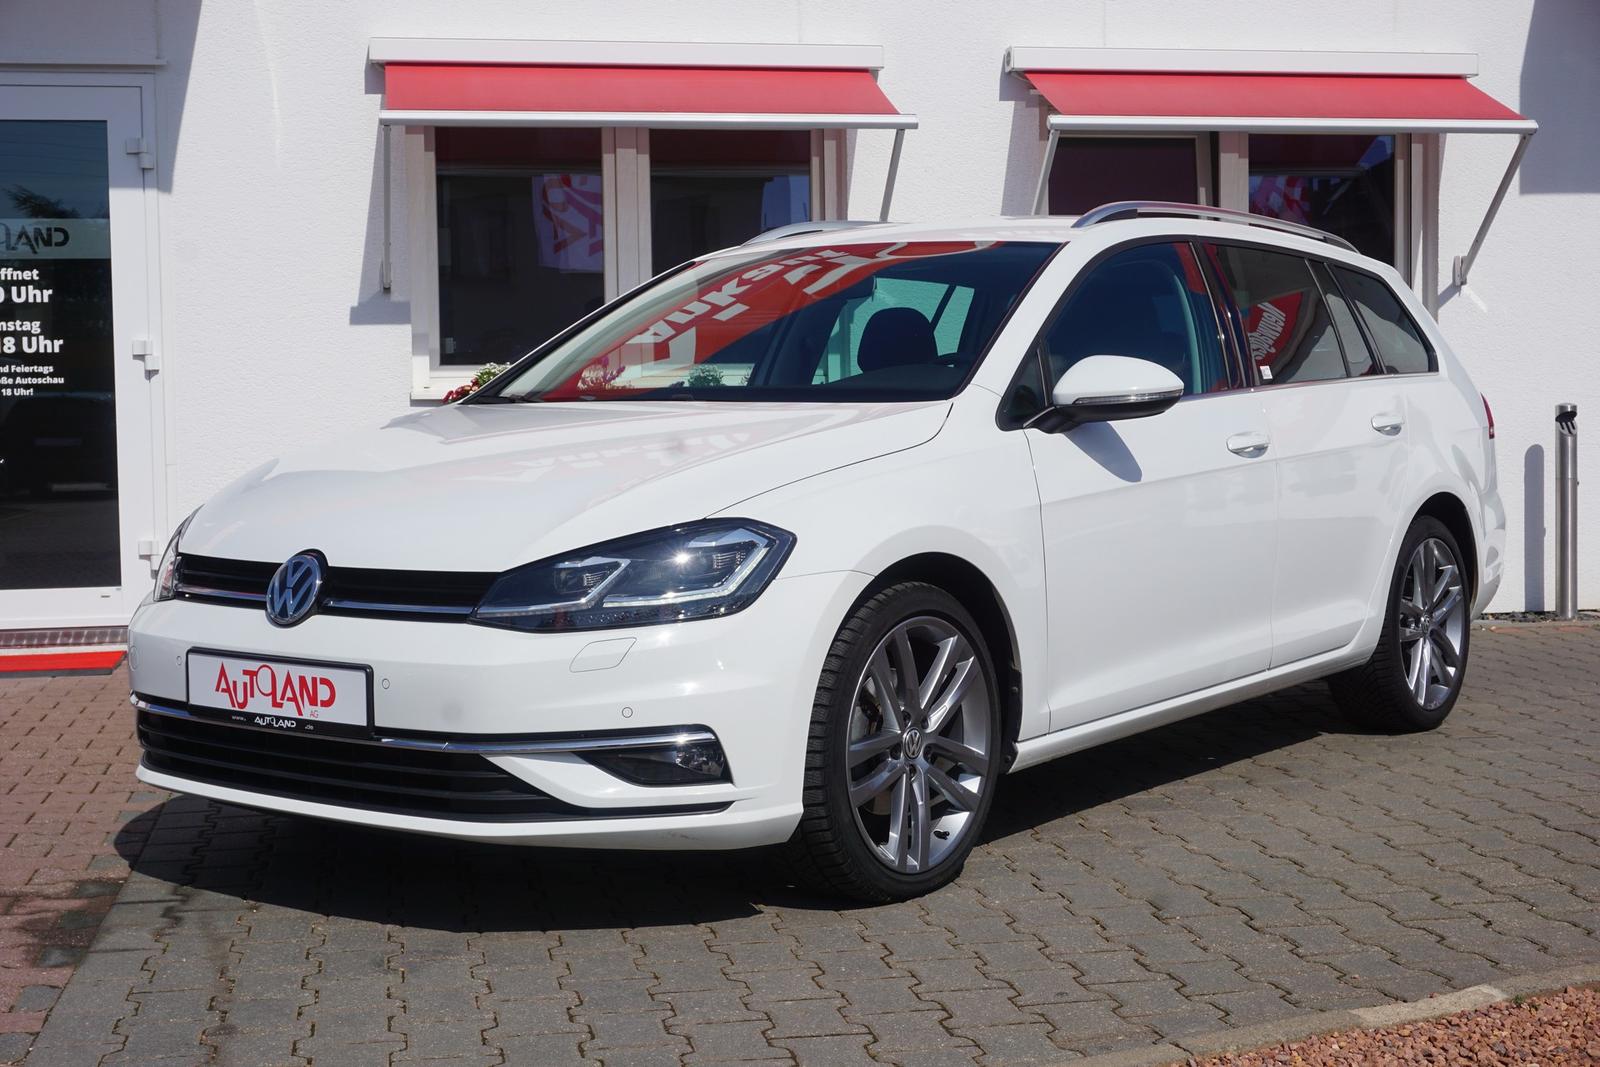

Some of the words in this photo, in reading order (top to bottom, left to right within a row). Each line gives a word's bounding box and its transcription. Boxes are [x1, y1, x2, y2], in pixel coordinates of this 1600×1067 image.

[11, 285, 53, 303] Uhr
[0, 336, 16, 353] 8
[22, 335, 64, 353] Uhr
[11, 364, 54, 374] Feiertags
[15, 376, 65, 384] Autoschau
[1, 388, 12, 396] 18
[13, 388, 34, 396] Uhr!
[254, 716, 297, 729] AUTOLAND
